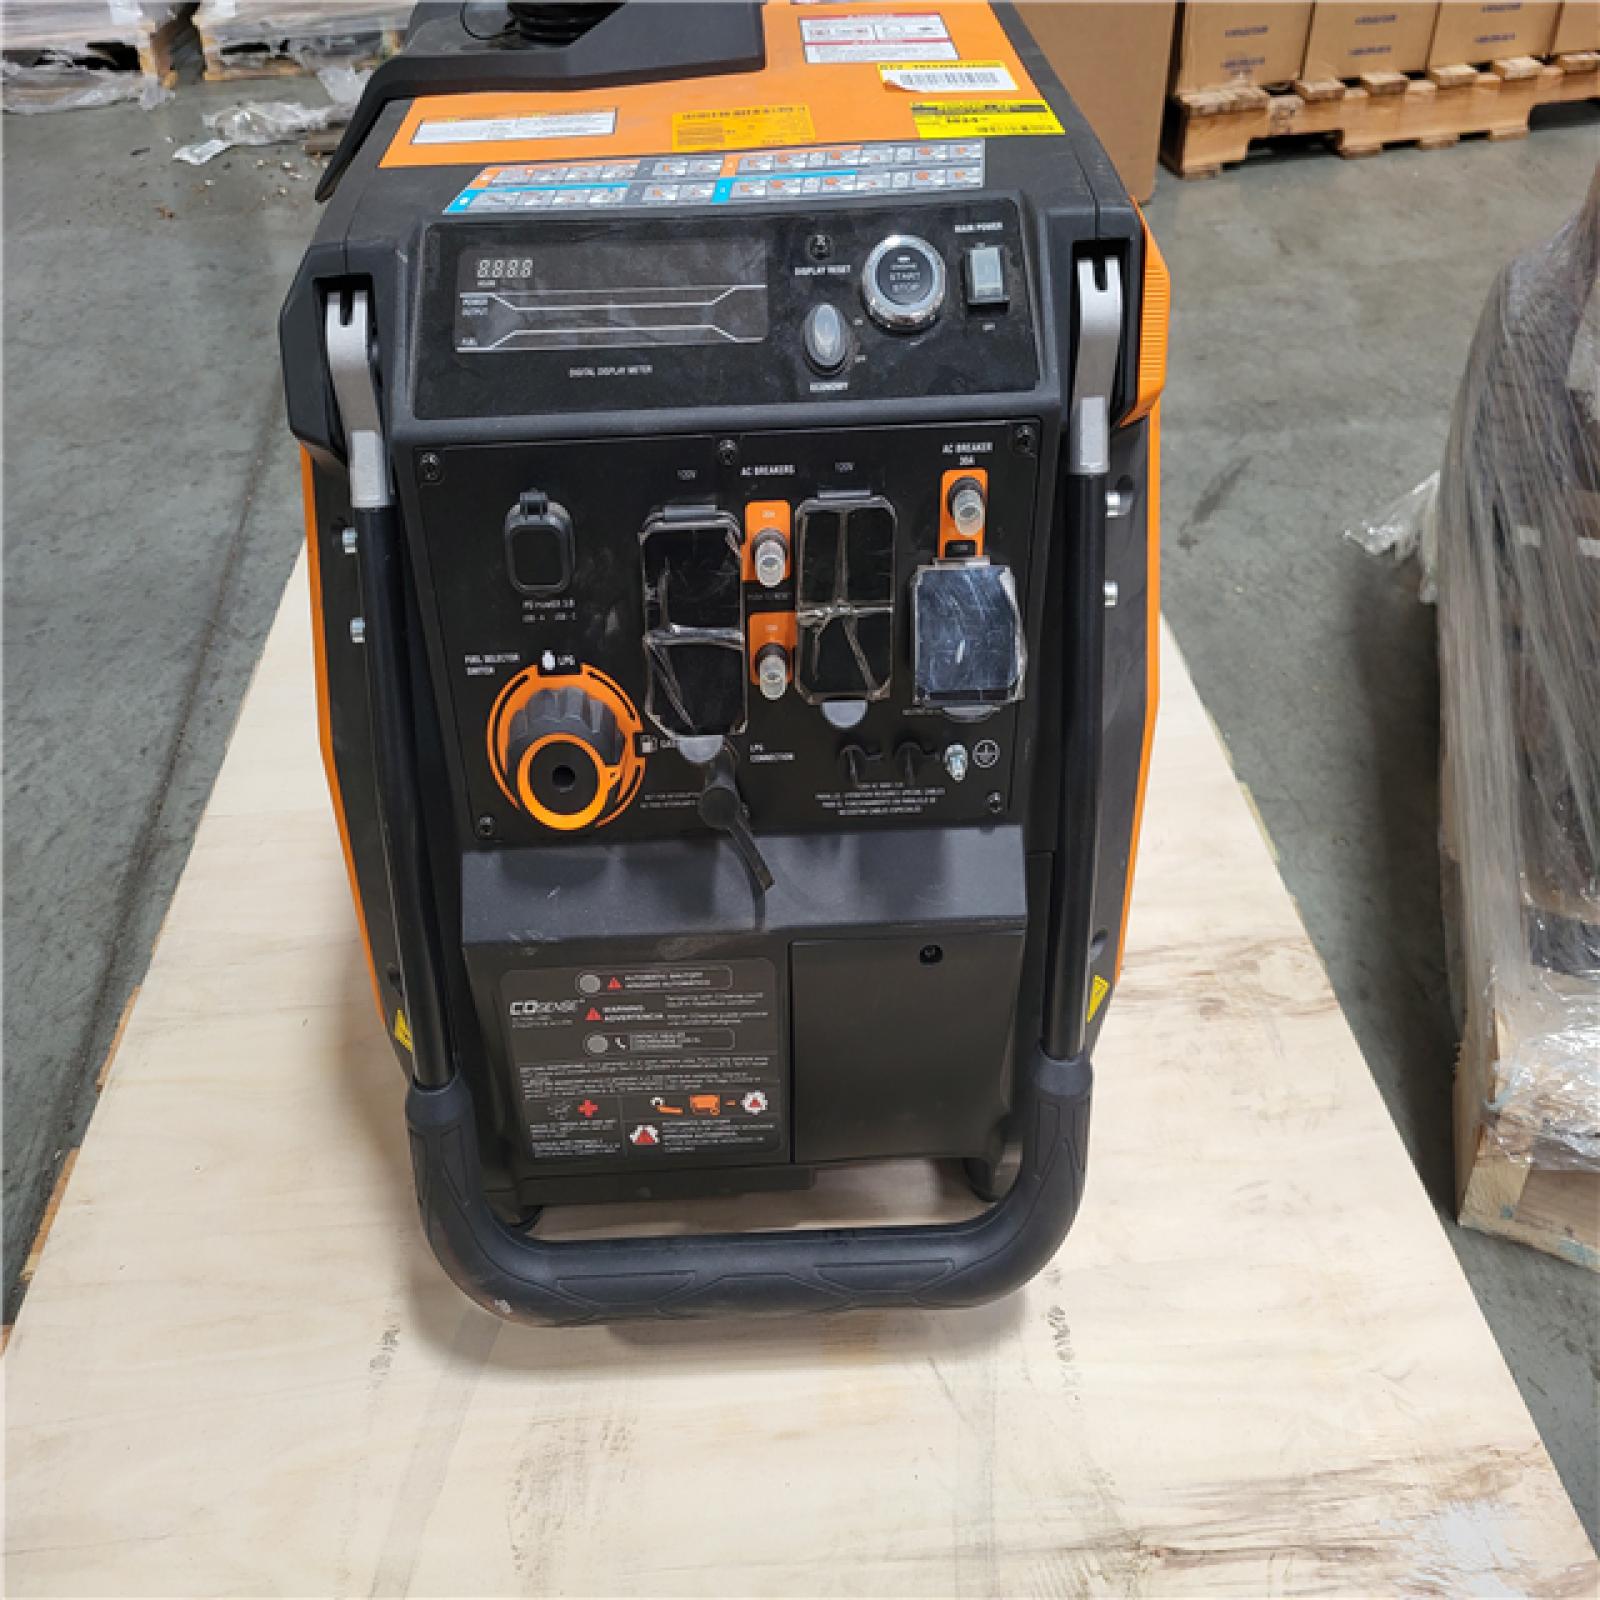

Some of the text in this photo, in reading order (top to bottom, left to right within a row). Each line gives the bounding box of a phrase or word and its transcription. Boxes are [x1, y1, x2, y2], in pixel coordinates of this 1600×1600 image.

[941, 441, 993, 454] AC BREAKER
[740, 464, 796, 476] AC BREAKERS
